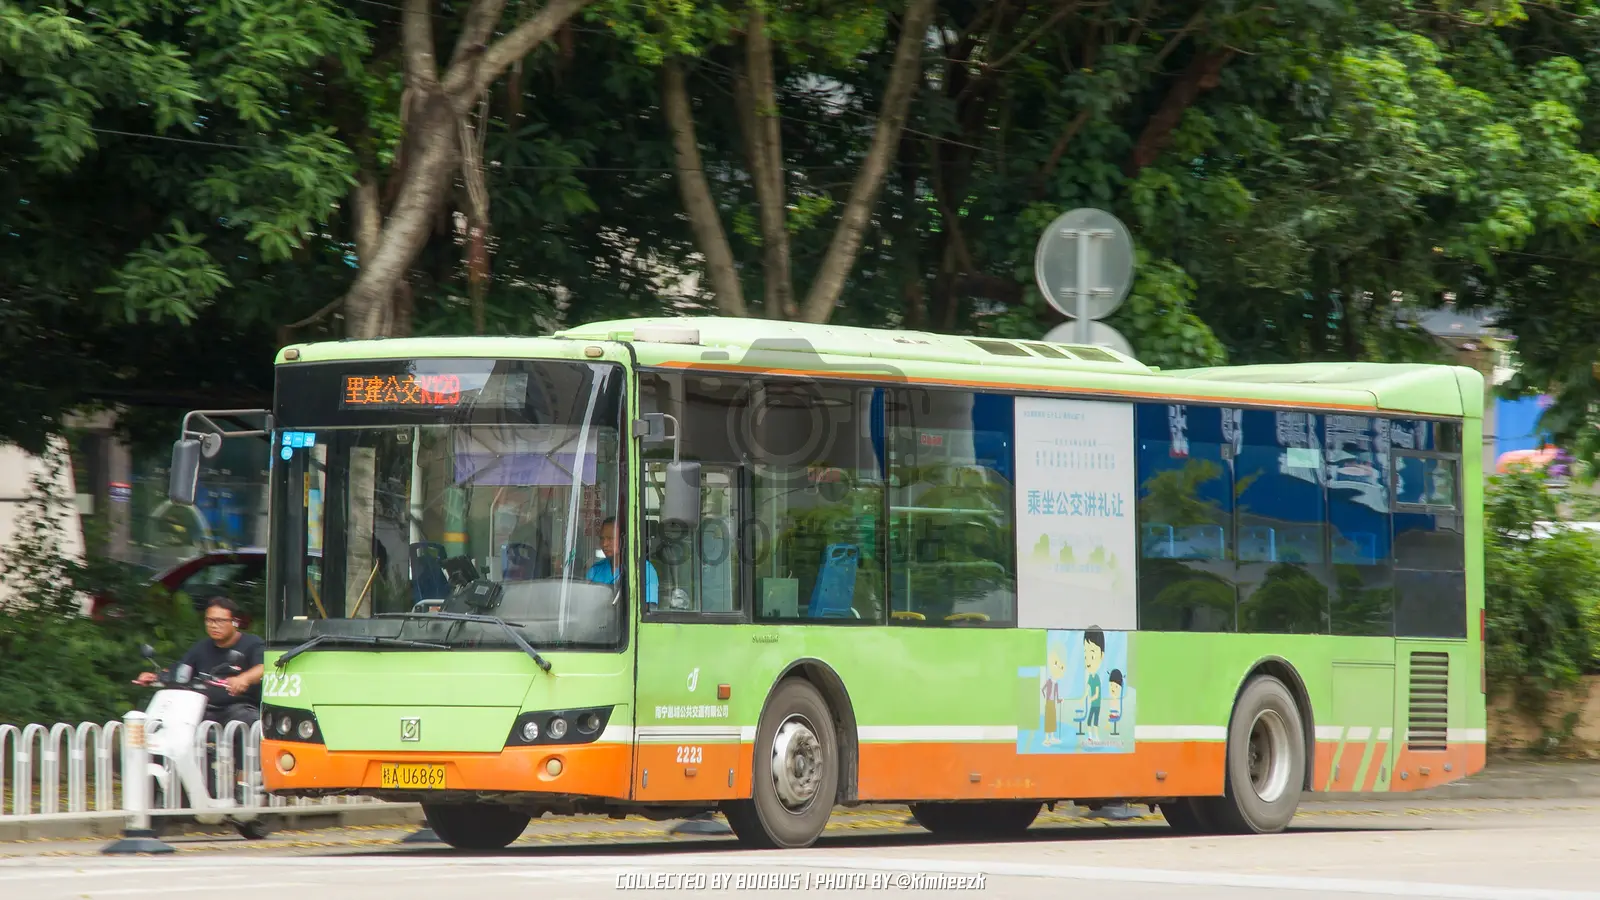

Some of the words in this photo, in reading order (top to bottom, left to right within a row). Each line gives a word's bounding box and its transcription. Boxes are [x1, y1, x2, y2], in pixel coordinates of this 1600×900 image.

[1027, 489, 1125, 518] 乘坐公交讲礼让
[263, 673, 301, 697] 2223
[676, 745, 703, 763] 2223
